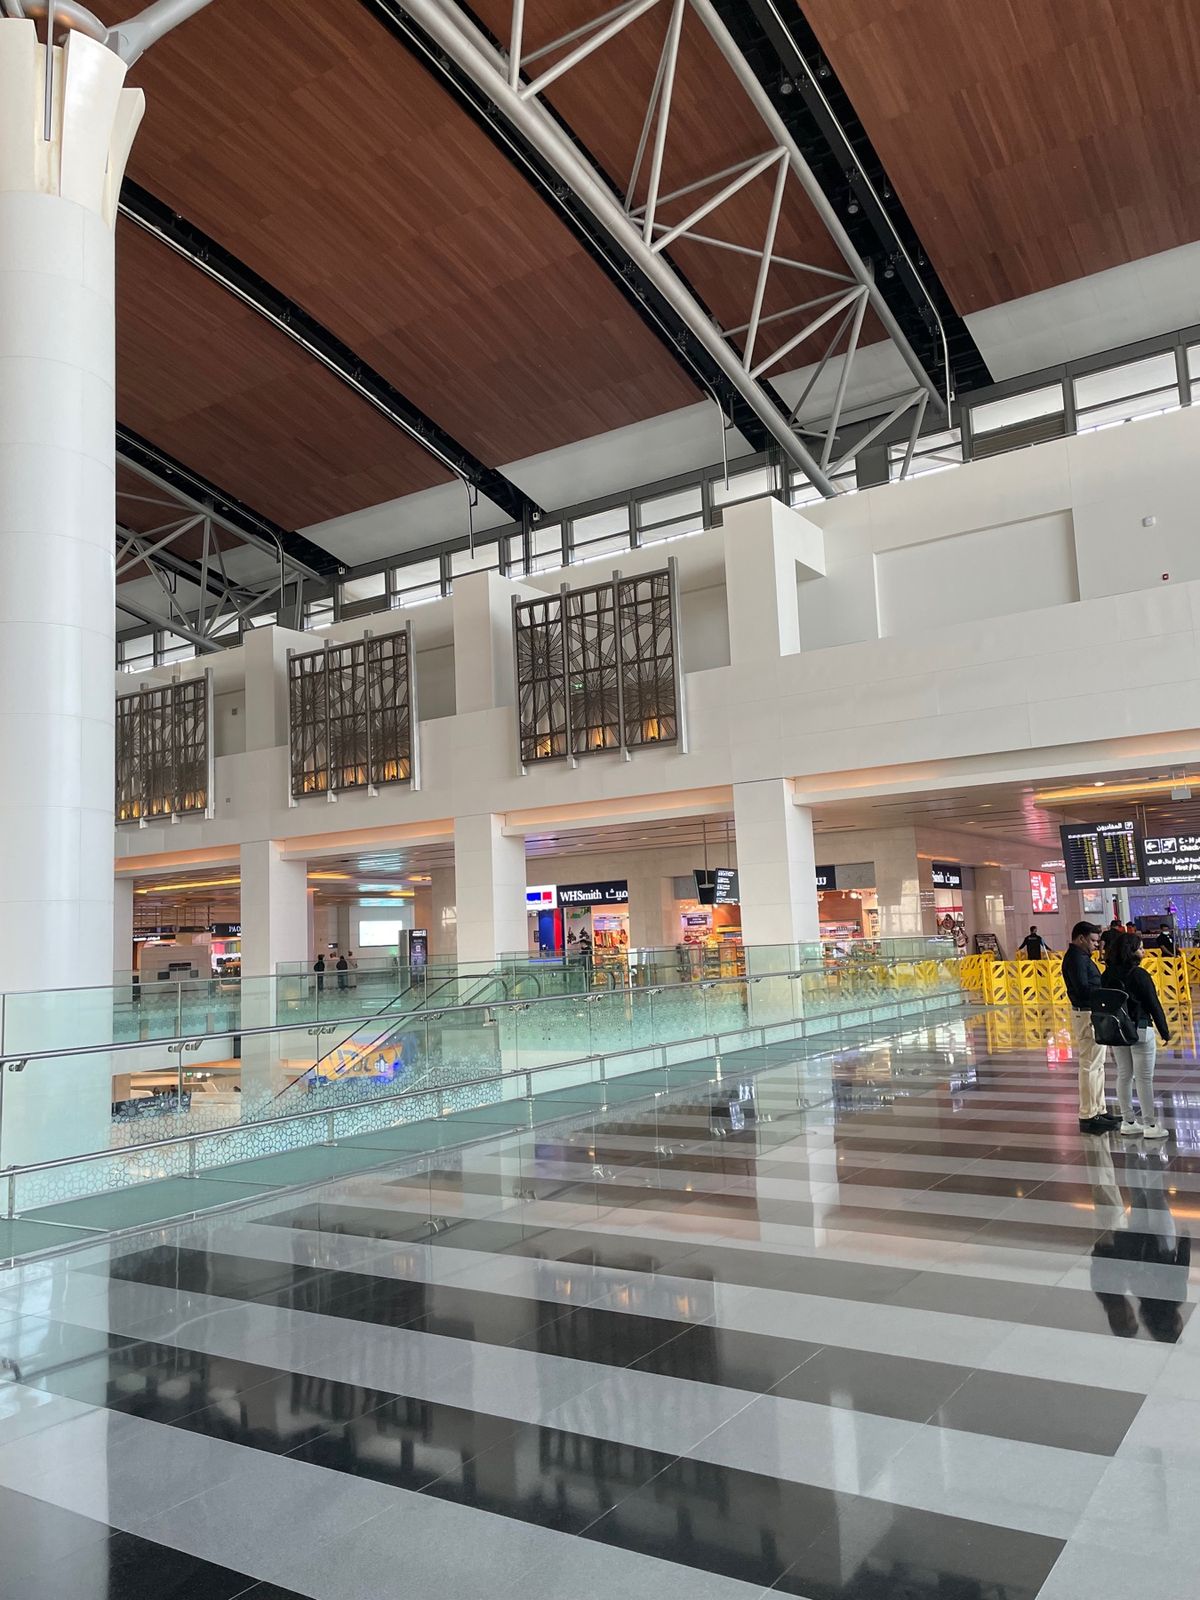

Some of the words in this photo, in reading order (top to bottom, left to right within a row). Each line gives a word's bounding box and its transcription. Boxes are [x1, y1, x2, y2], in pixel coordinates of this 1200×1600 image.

[931, 870, 944, 882] Smith
[559, 889, 602, 902] WHSmith
[605, 888, 629, 901] ميث
